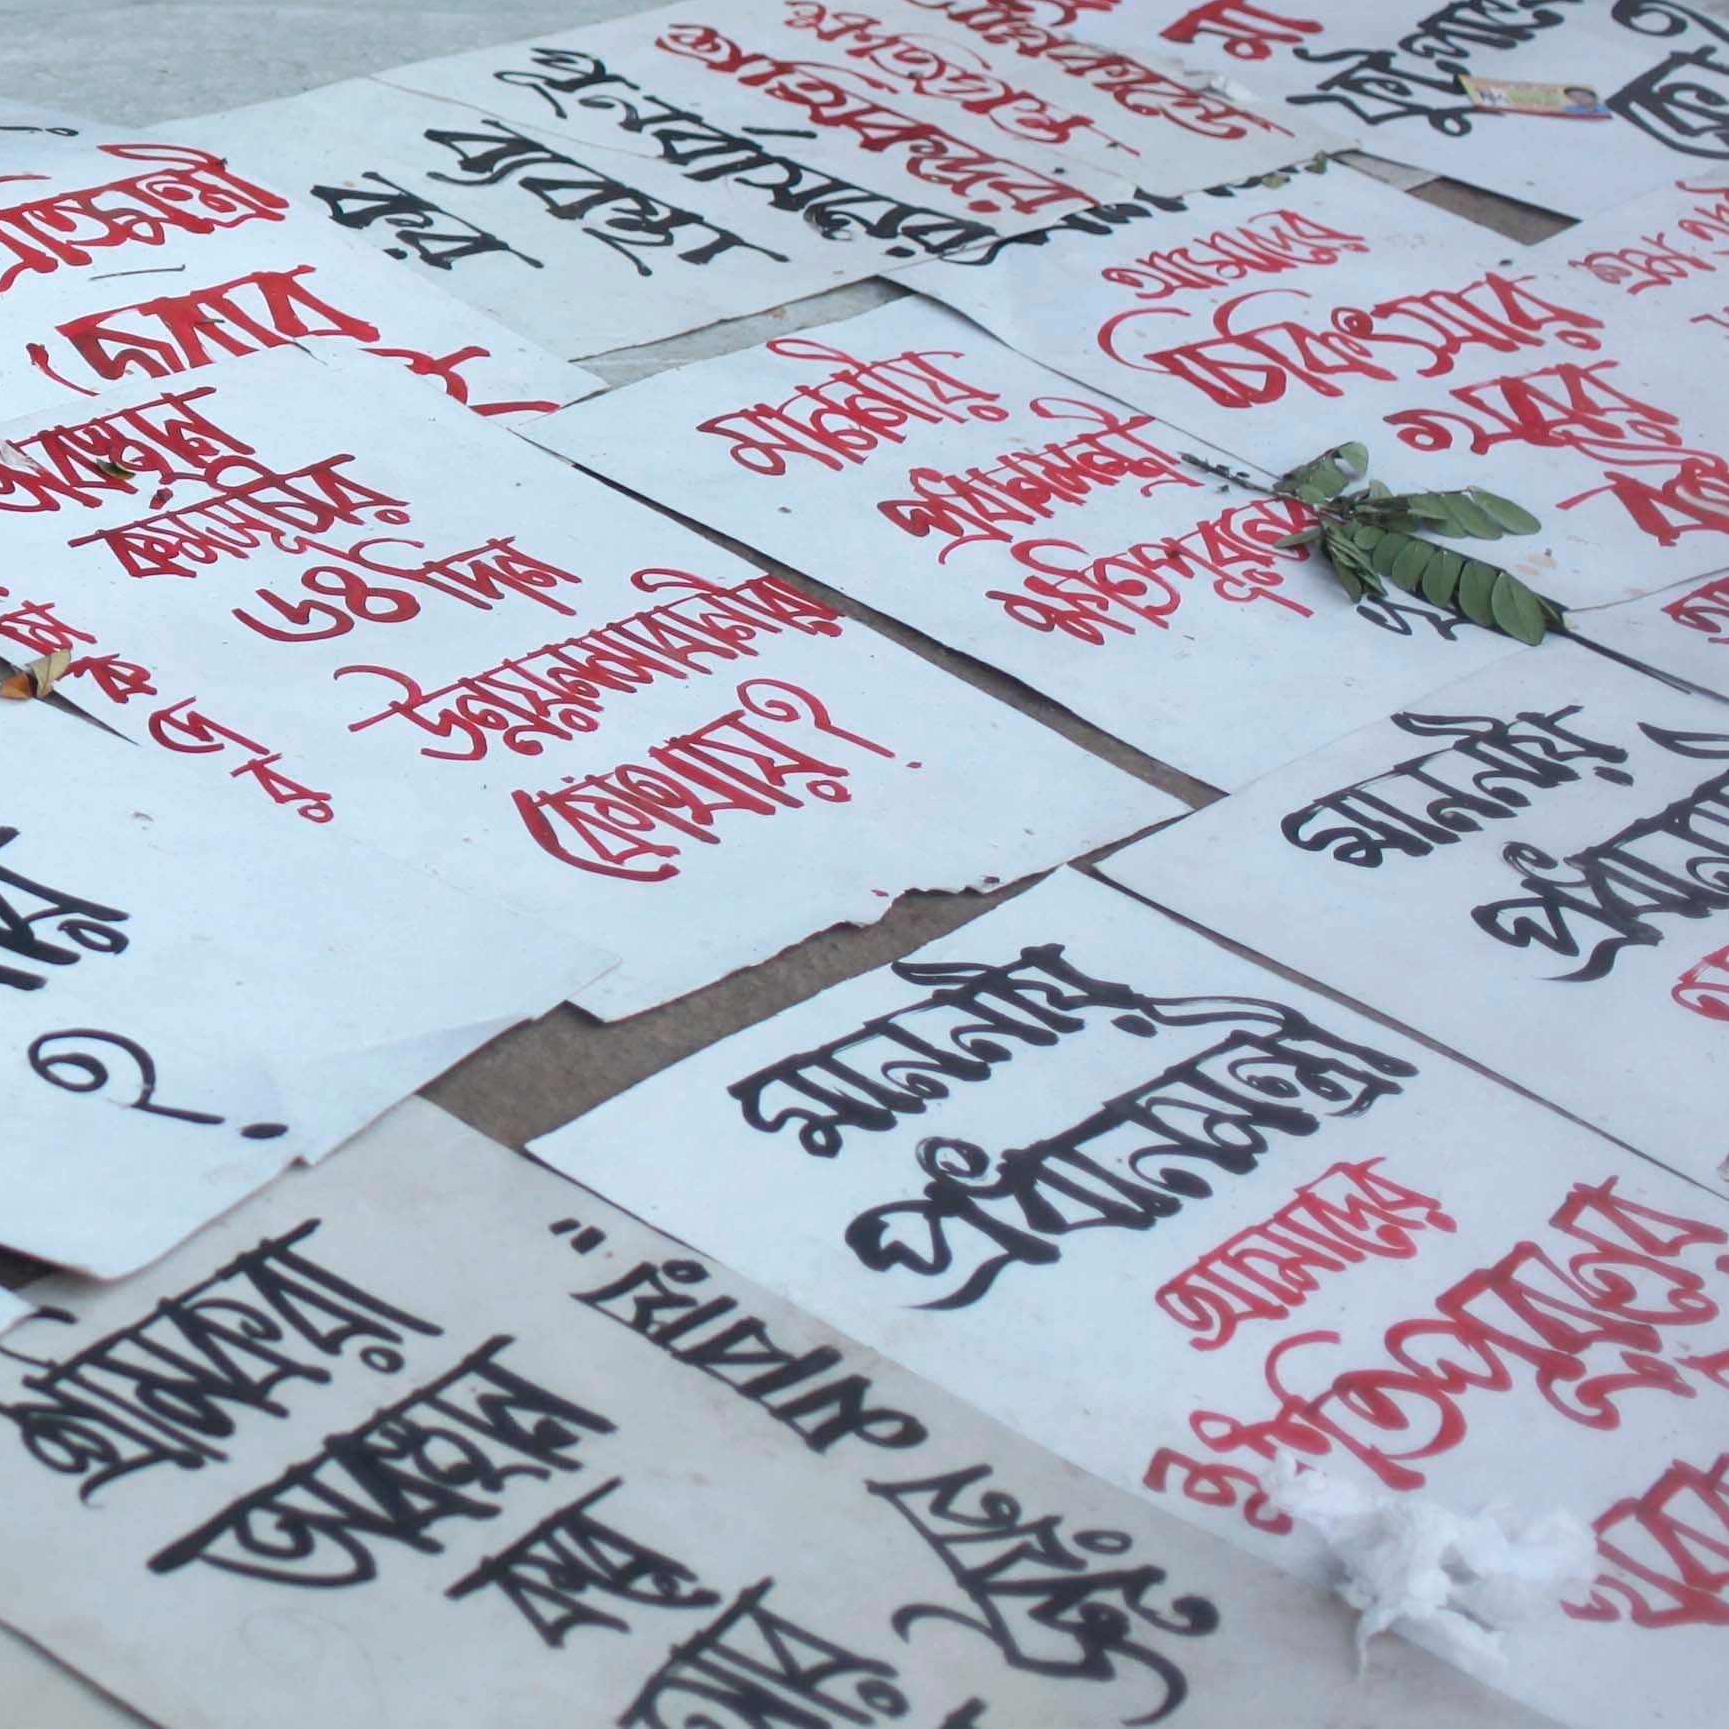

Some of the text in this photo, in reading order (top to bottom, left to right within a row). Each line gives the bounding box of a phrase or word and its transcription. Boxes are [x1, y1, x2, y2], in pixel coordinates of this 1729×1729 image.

[695, 335, 1011, 476] মাননীয়
[1095, 270, 1606, 414] চিকিৎসার
[877, 396, 1205, 565] প্রধানমন্ত্রী
[232, 535, 583, 644] ৬৪ দিন
[1280, 704, 1634, 871] মাননীয়
[728, 942, 1164, 1160] মাননীয়
[843, 994, 1419, 1311] প্রধানমন্ত্রী
[1154, 1155, 1459, 1352] আমাদের
